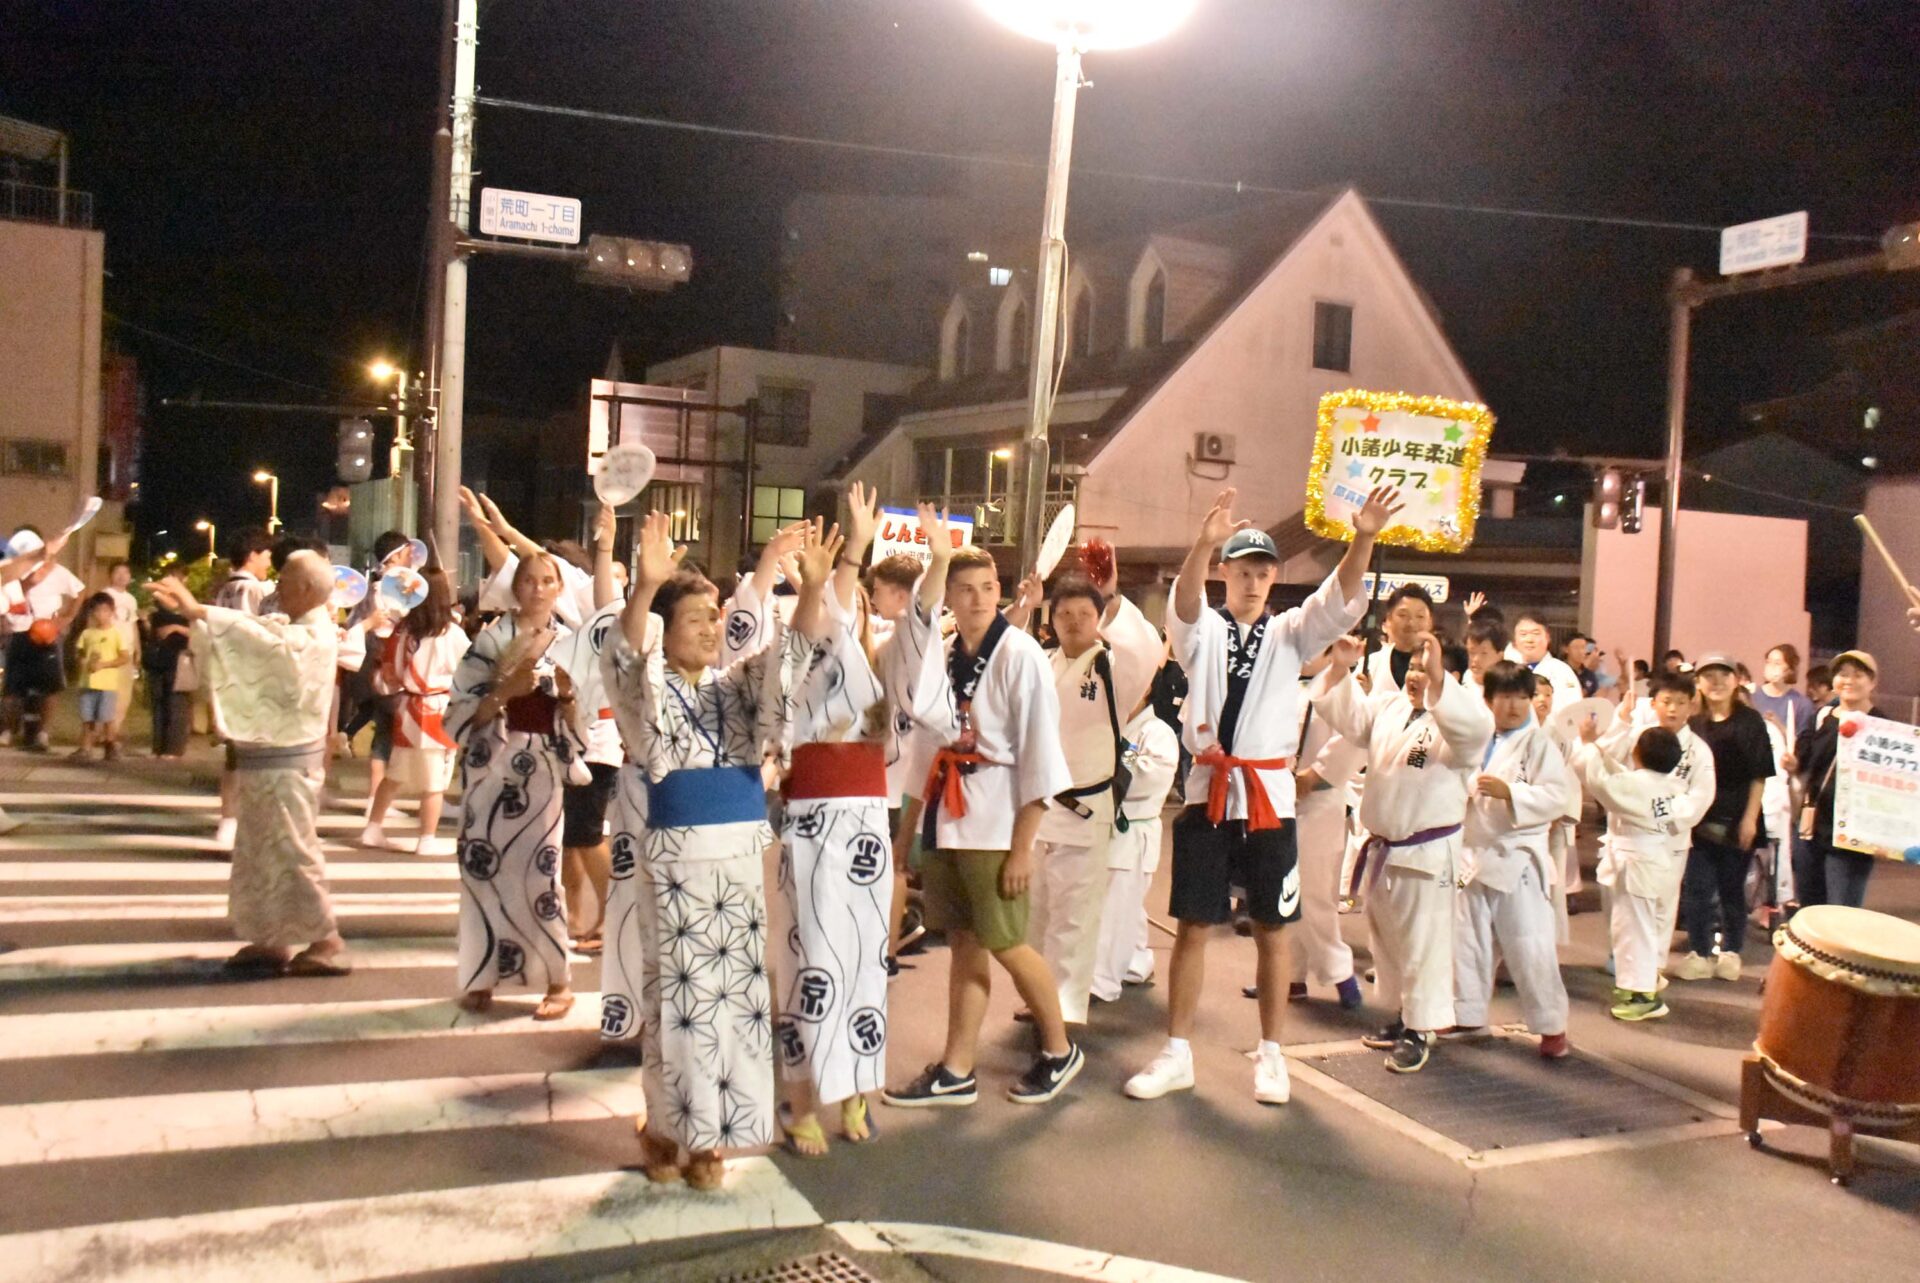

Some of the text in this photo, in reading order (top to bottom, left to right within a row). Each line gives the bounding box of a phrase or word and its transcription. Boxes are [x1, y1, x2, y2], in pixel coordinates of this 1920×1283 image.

[500, 197, 575, 223] 荒町一丁目
[500, 216, 575, 237] Aramachi 1-chome
[1340, 437, 1465, 467] 小諸少年柔道
[1407, 727, 1432, 769] 小諸
